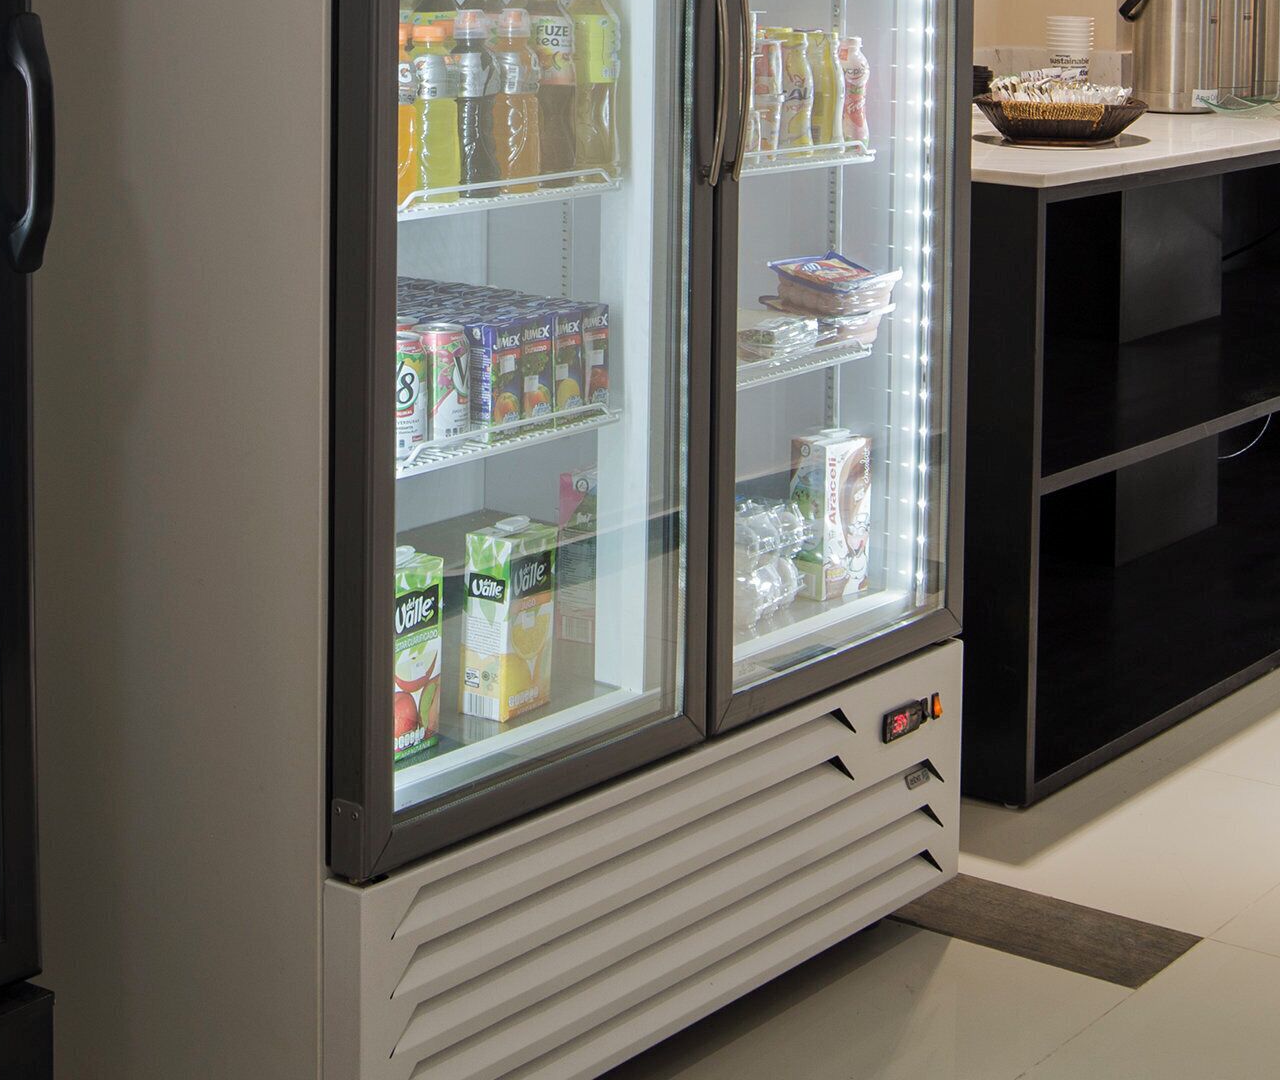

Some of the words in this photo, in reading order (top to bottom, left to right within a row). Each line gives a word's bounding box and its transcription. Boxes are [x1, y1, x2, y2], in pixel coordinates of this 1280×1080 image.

[536, 25, 569, 37] FUZE
[536, 36, 560, 47] tea
[522, 324, 550, 341] JUMEX
[472, 578, 503, 598] Valle
[406, 597, 416, 610] del
